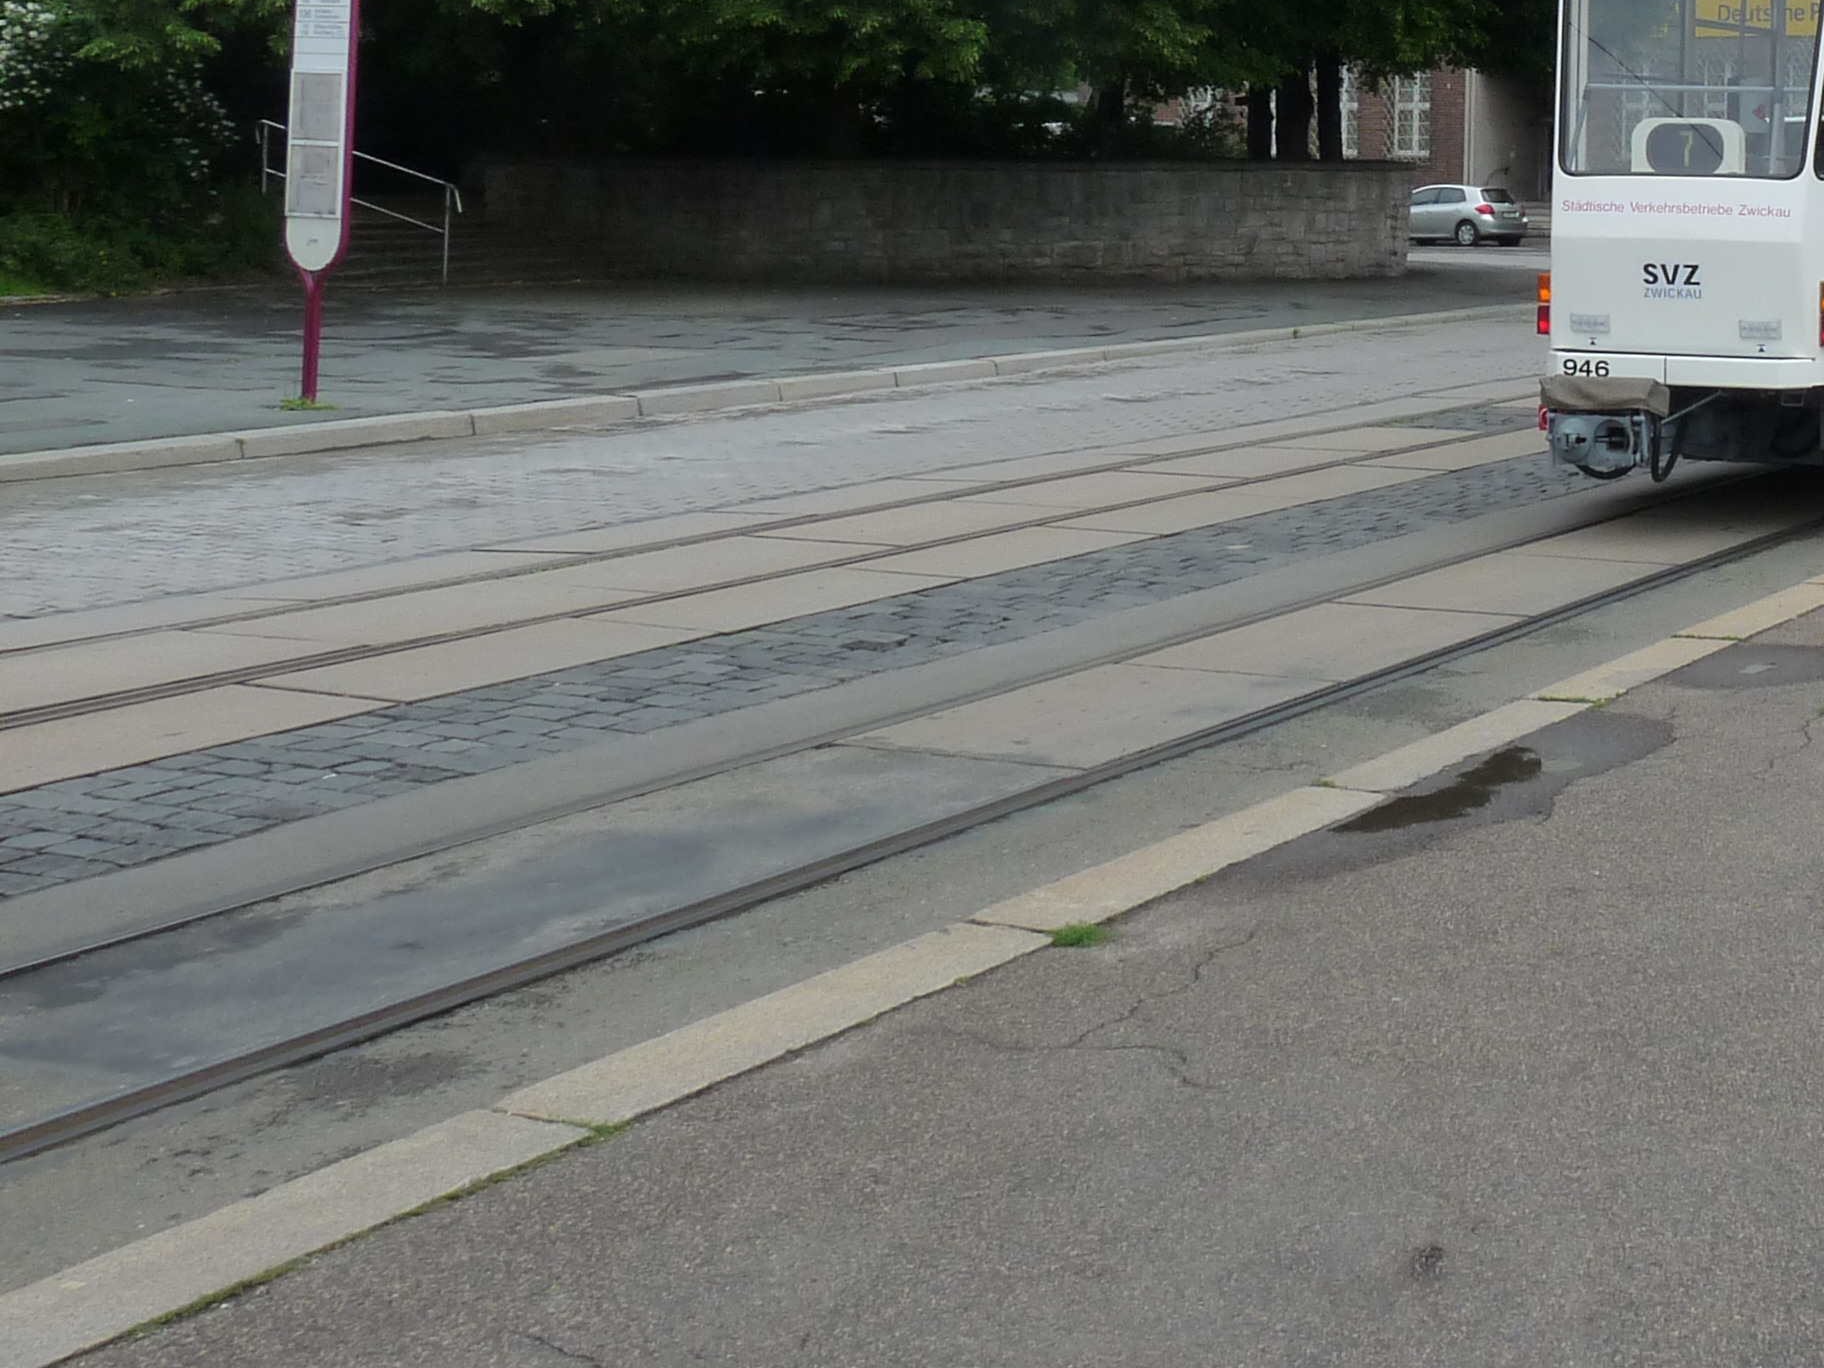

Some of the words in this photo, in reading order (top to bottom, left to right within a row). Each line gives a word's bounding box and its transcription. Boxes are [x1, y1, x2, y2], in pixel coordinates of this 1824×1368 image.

[1679, 130, 1694, 167] 7
[1562, 199, 1624, 213] Städtische
[1629, 201, 1733, 216] Verkehrsbetriebe
[1737, 204, 1791, 219] Zwickau
[1642, 262, 1701, 286] SVZ
[1643, 287, 1702, 300] ZWICKAU
[1562, 358, 1610, 378] 946
